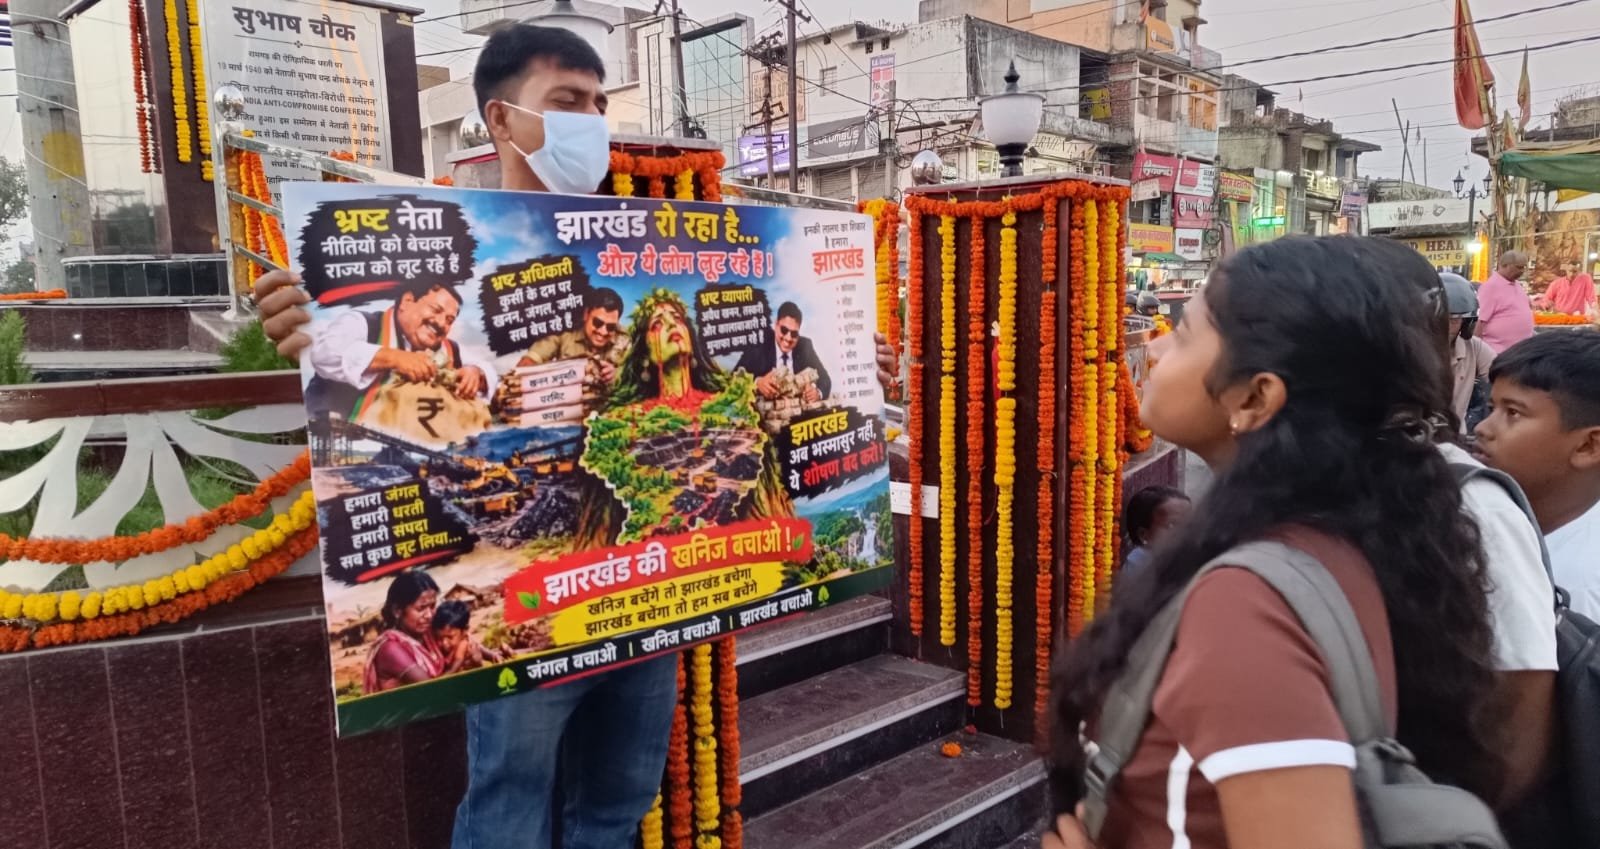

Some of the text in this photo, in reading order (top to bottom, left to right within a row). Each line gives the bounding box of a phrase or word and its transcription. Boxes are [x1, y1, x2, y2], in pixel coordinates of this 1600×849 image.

[232, 6, 356, 41] सुभाष चौक
[244, 96, 262, 106] NDIA
[264, 99, 329, 113] ANTI-COMPROMISE
[252, 85, 283, 96] भारतीय
[334, 200, 443, 233] भ्रष्ट नेता
[554, 202, 649, 246] झारखंड
[653, 202, 678, 238] रो
[682, 211, 720, 243] रहा
[321, 233, 454, 257] नीतियों को बेचकर
[812, 243, 865, 276] झारखंड
[324, 261, 366, 279] राज्य
[369, 256, 393, 275] को
[396, 258, 422, 279] लूट
[425, 253, 446, 274] रहे
[519, 256, 573, 285] अधिकारी
[597, 243, 638, 278] और
[640, 243, 658, 276] ये
[659, 244, 695, 275] लोग
[696, 250, 728, 283] लूट
[728, 247, 751, 278] रहे
[526, 286, 538, 301] के
[540, 283, 557, 299] दम
[558, 279, 572, 293] पर
[556, 292, 584, 311] जमीन
[721, 285, 753, 303] व्यापारी
[508, 327, 528, 343] सब
[548, 315, 563, 332] रहे
[789, 407, 849, 447] झारखंड
[789, 445, 809, 465] अब
[811, 430, 856, 454] भस्मासुर
[788, 469, 801, 491] ये
[802, 460, 840, 487] शोषण
[343, 483, 420, 513] हमारा जंगल
[350, 498, 425, 530] हमारी धरती
[351, 517, 429, 550] हमारी संपदा
[340, 552, 364, 570] सब
[366, 545, 393, 567] कुछ
[395, 539, 417, 559] लूट
[543, 552, 632, 605] झारखंड
[635, 541, 667, 577] की
[671, 532, 728, 569] खनिज
[587, 596, 626, 616] खनिज
[664, 582, 677, 602] तो
[680, 573, 721, 597] झारखंड
[585, 612, 632, 637] झारखंड
[675, 597, 690, 615] तो
[691, 596, 708, 612] हम
[712, 590, 730, 605] सब
[526, 659, 569, 680] जंगल
[640, 628, 681, 654] खनिज
[739, 599, 779, 628] झारखंड
